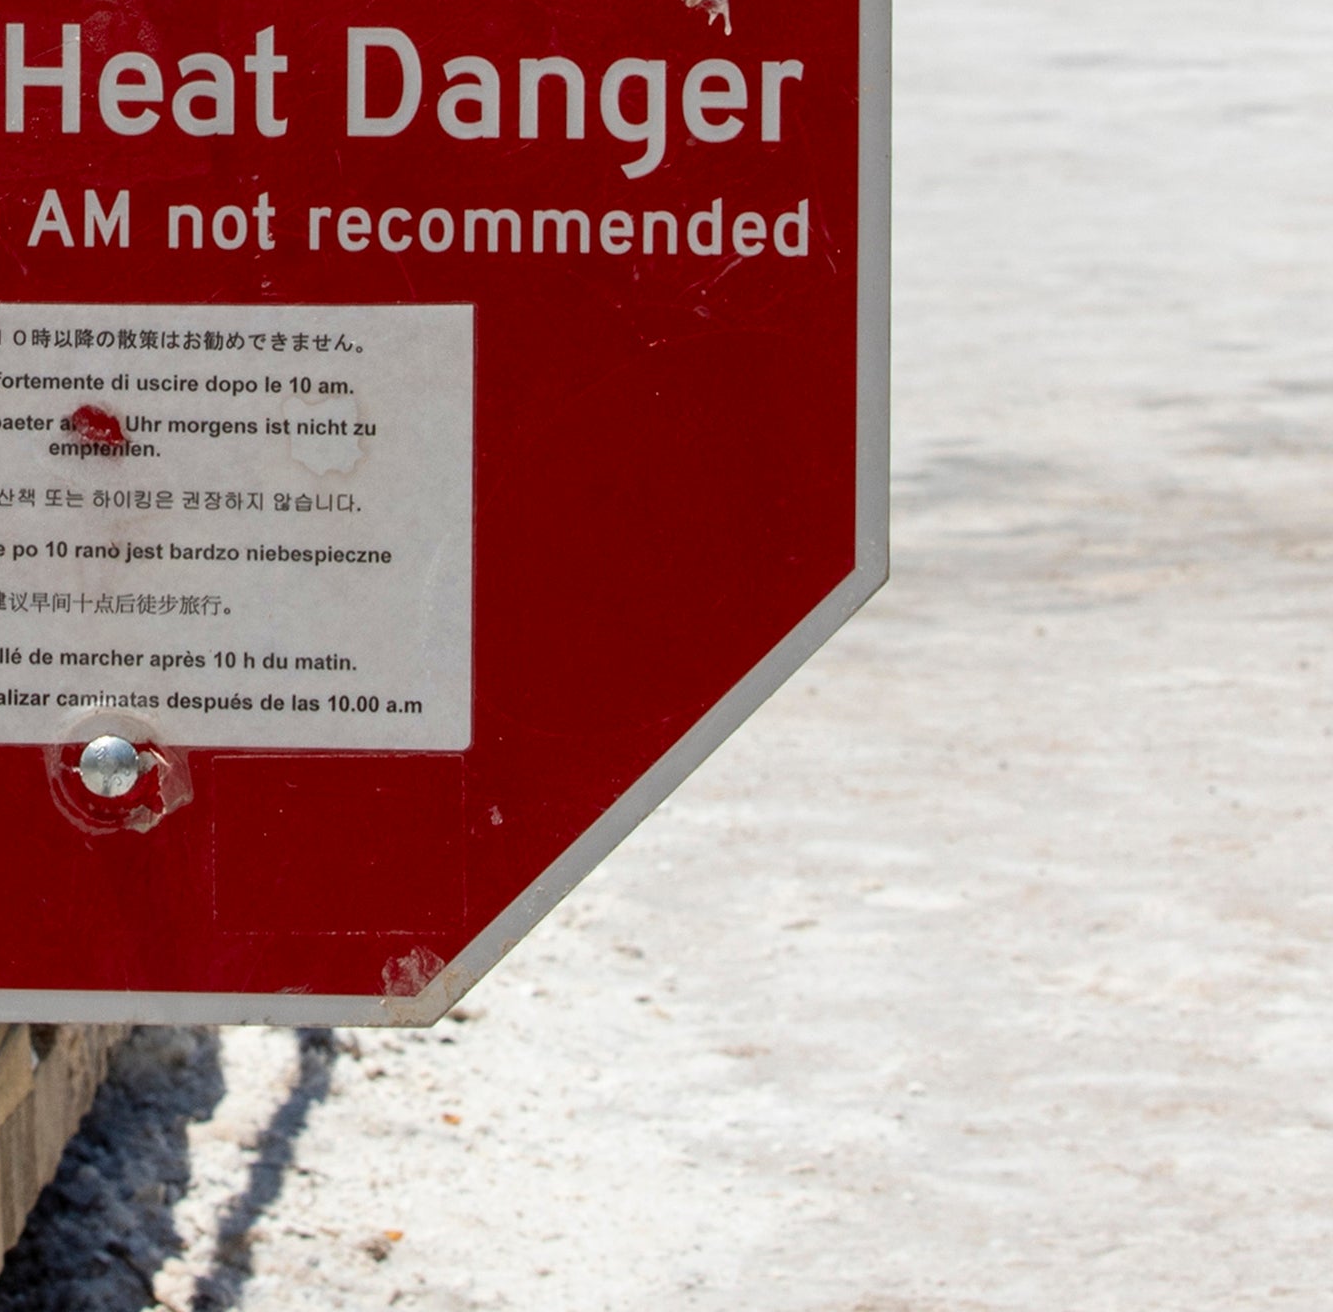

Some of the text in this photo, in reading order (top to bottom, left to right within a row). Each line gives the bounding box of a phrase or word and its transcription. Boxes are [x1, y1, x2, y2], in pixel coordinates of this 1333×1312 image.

[4, 23, 289, 138] Heat
[346, 26, 805, 180] Danger
[24, 190, 129, 247] AM
[169, 192, 275, 249] not
[310, 198, 808, 256] recommended
[110, 373, 128, 390] di
[136, 374, 198, 392] uscire
[205, 375, 257, 396] dopo
[264, 375, 282, 393] le
[289, 376, 311, 393] 10
[317, 380, 353, 394] am.
[125, 415, 163, 434] Uhr
[168, 420, 257, 437] morgens
[265, 417, 290, 435] ist
[296, 418, 347, 435] nicht
[353, 422, 376, 436] zu
[45, 488, 83, 507] 또는
[92, 489, 173, 509] 하이킹은
[182, 491, 262, 510] 권장하지
[273, 492, 361, 512] 않습니다.
[12, 544, 38, 560] po
[45, 540, 67, 557] 10
[75, 542, 120, 559] rano
[124, 541, 163, 563] jest
[169, 542, 239, 560] bardzo
[246, 544, 391, 566] niebespieczne
[28, 647, 53, 665] de
[60, 649, 144, 666] marcher
[149, 650, 205, 671] après
[213, 651, 236, 668] 10
[243, 651, 255, 668] h
[262, 652, 287, 669] du
[294, 653, 356, 670] matin.
[56, 690, 159, 708] caminatas
[166, 691, 253, 713] después
[259, 693, 284, 711] de
[291, 694, 320, 711] las
[327, 694, 379, 712] 10.00
[385, 699, 422, 713] a.m
